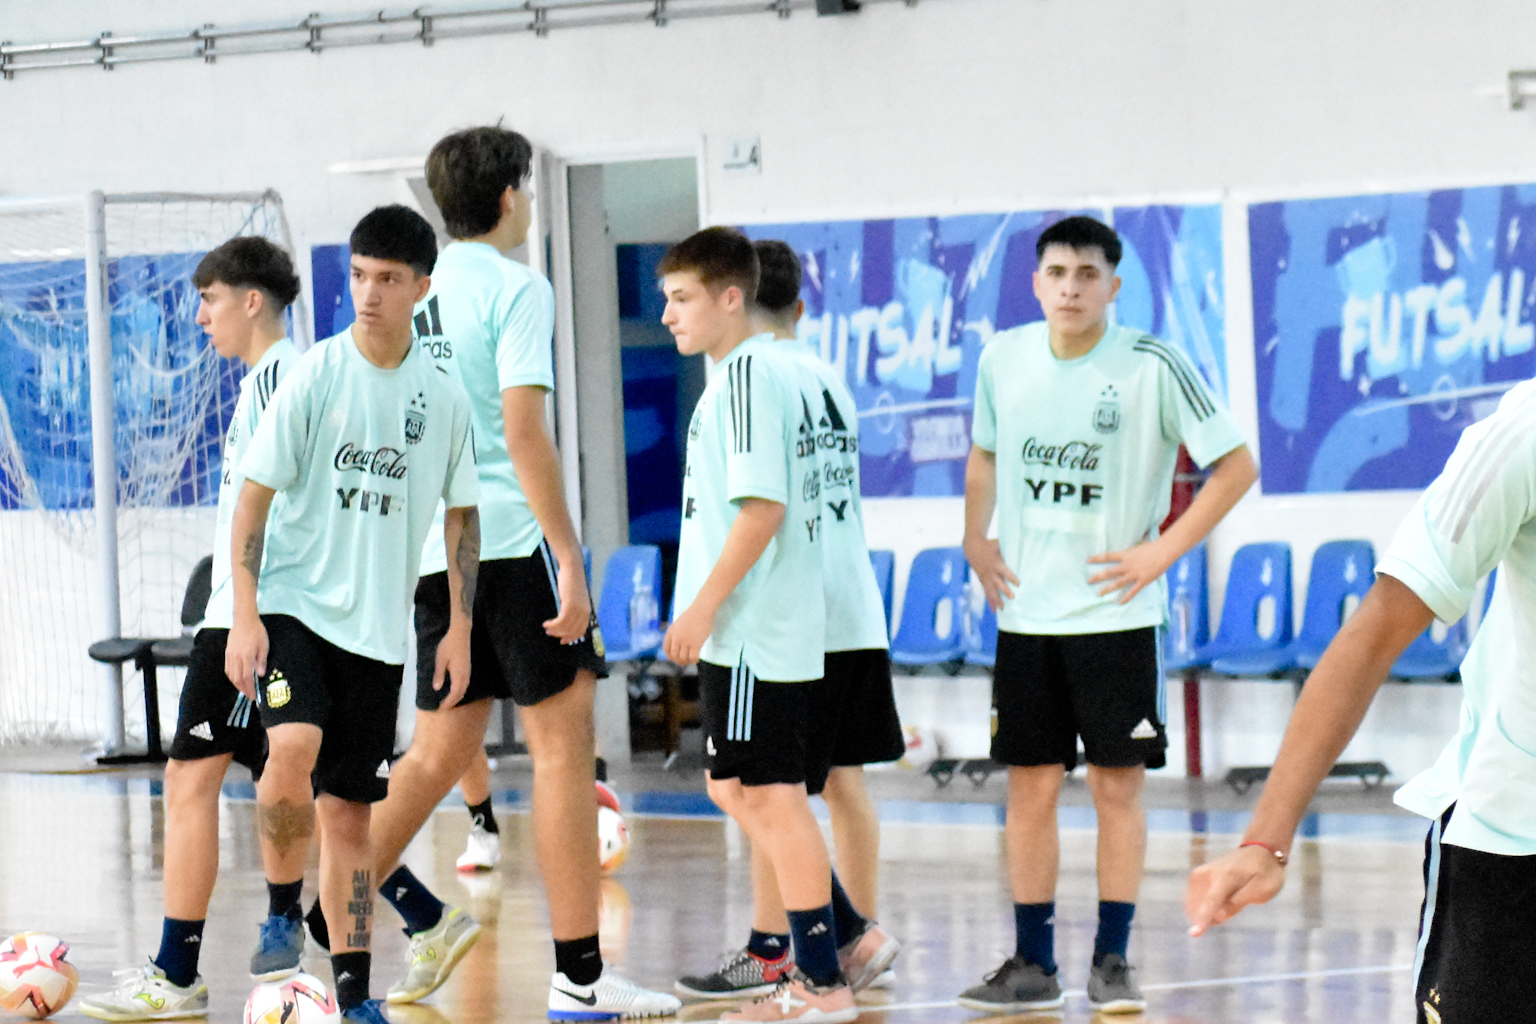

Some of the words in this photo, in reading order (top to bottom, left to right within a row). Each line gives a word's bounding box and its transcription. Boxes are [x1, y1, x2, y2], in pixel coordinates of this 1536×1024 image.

[1339, 267, 1535, 380] FUTSAL
[334, 442, 407, 480] Coca-Cola
[1022, 437, 1103, 471] Coca-Cola
[1024, 478, 1104, 506] YPF
